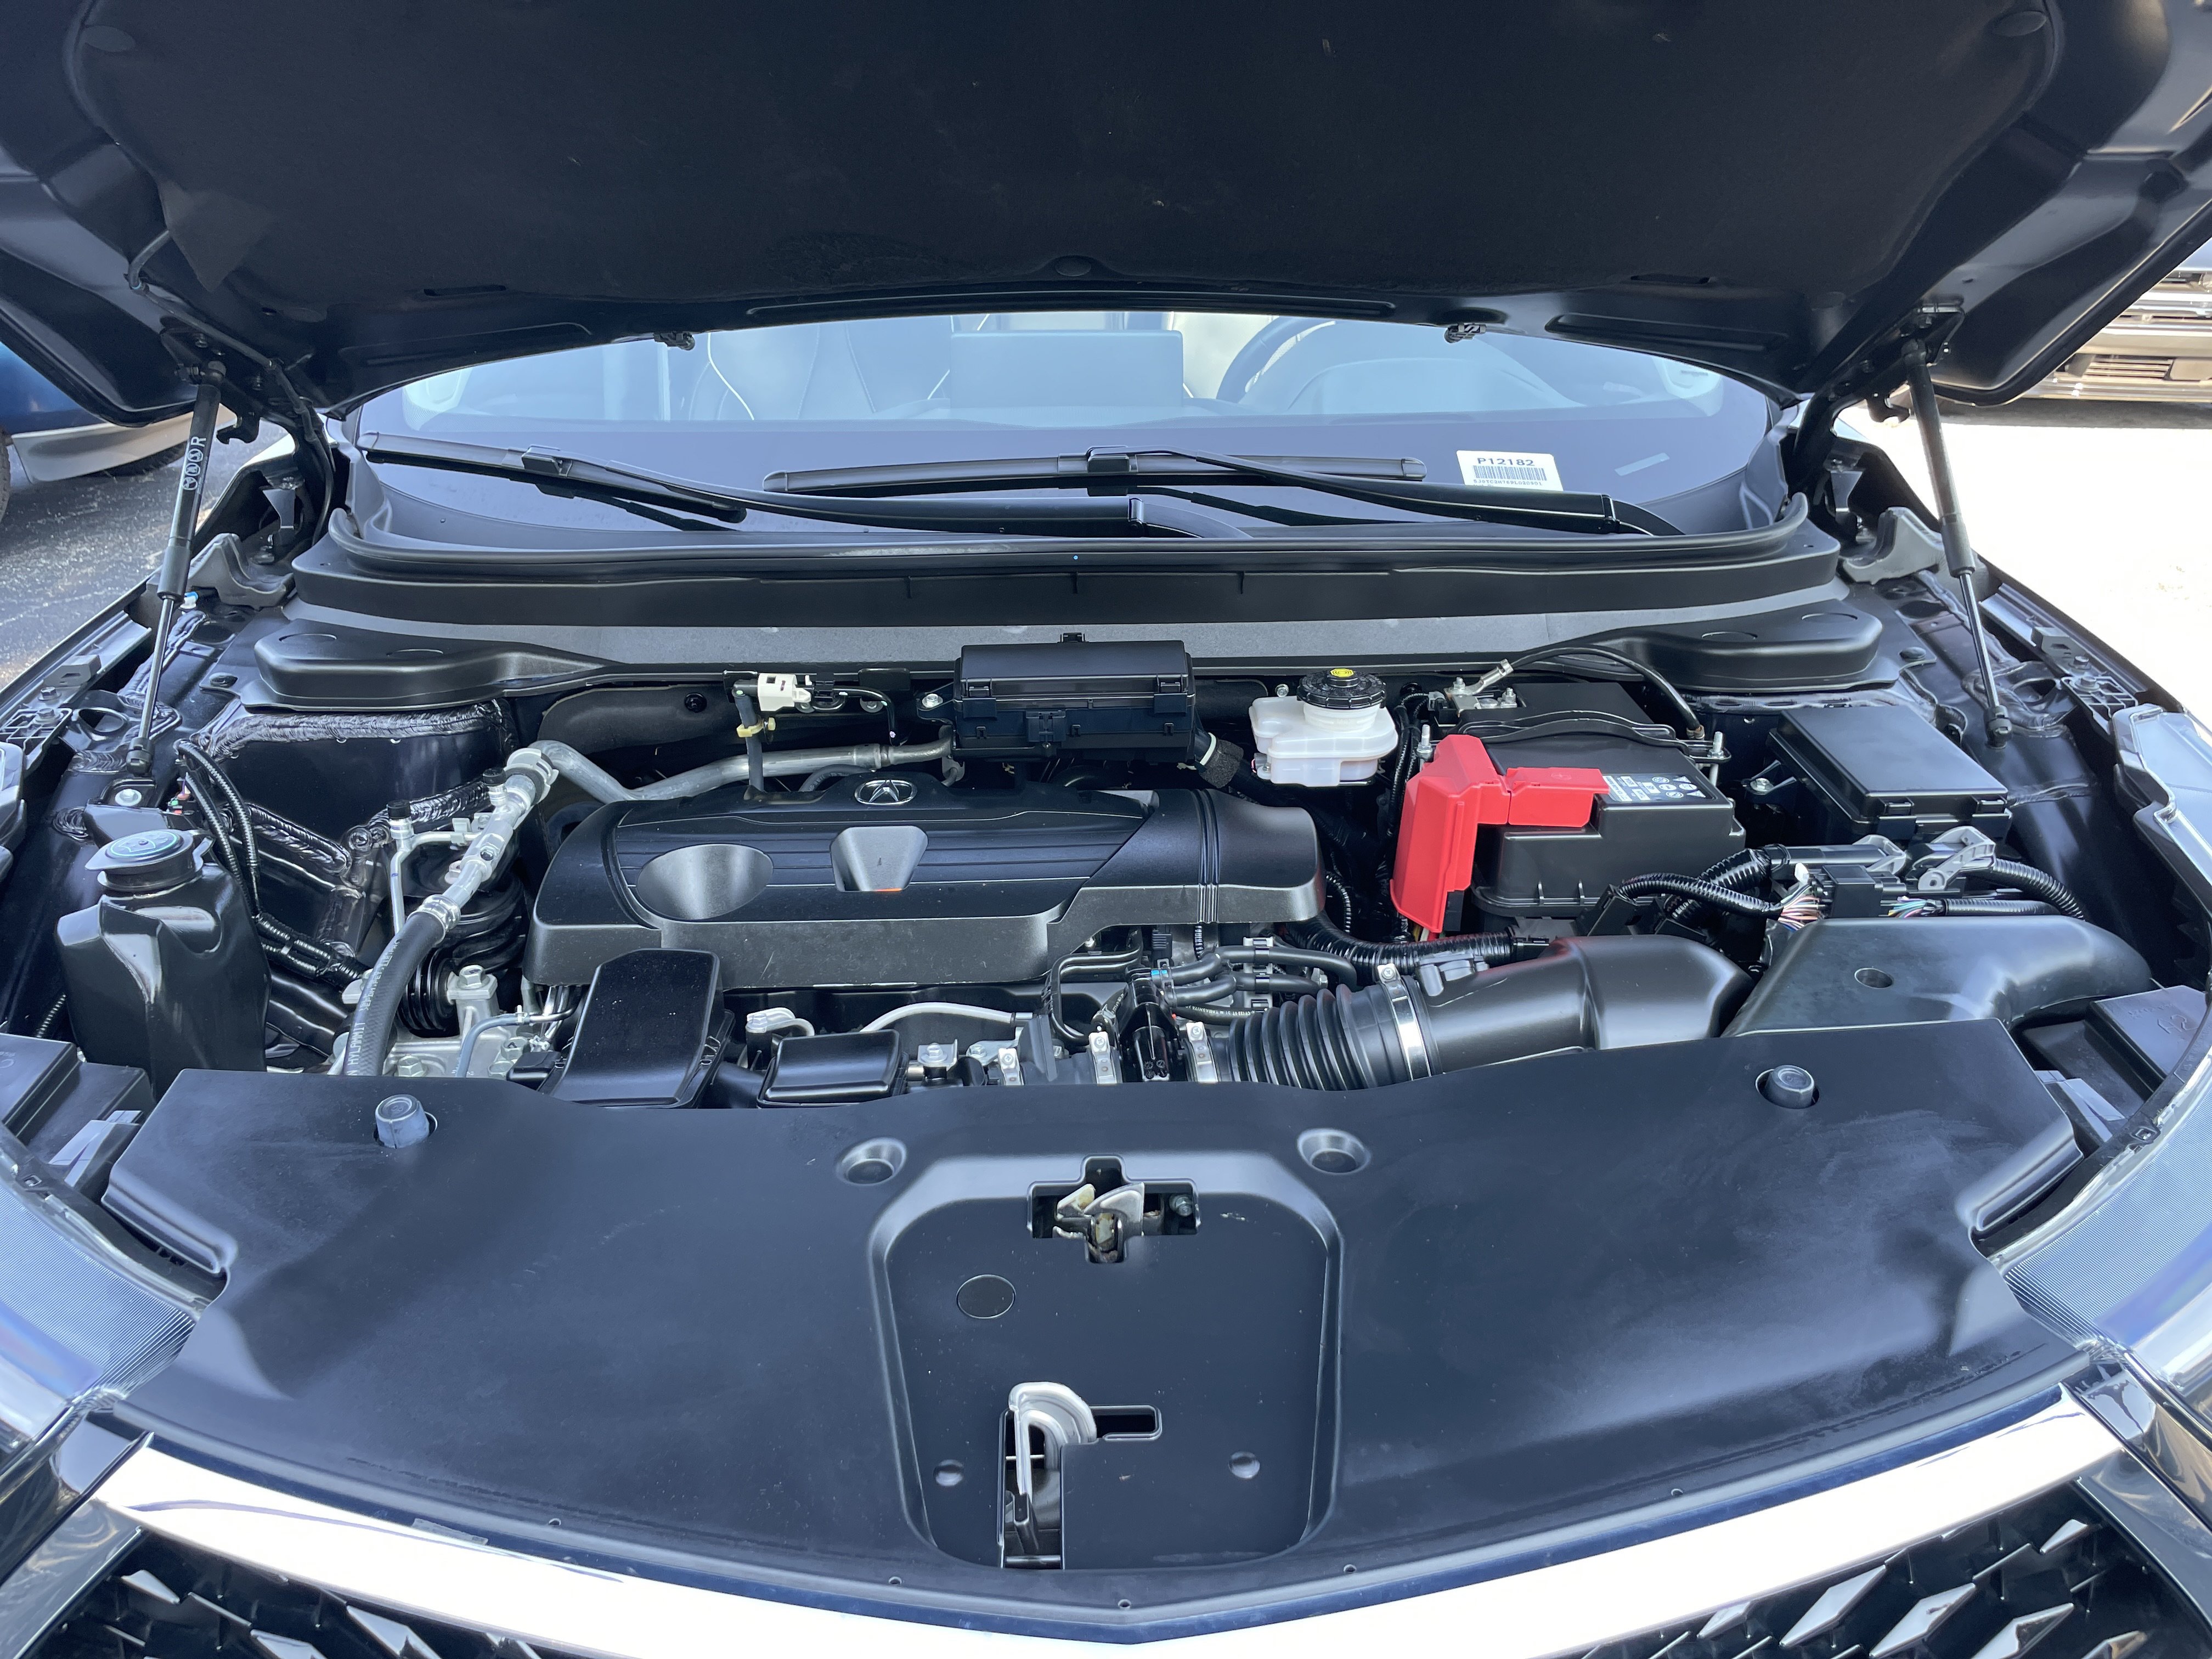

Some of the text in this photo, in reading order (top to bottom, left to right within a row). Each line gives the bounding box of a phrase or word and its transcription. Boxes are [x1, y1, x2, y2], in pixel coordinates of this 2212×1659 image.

[190, 436, 206, 447] R
[1477, 458, 1535, 466] P12182
[347, 1022, 366, 1066] HYLAMMIT
